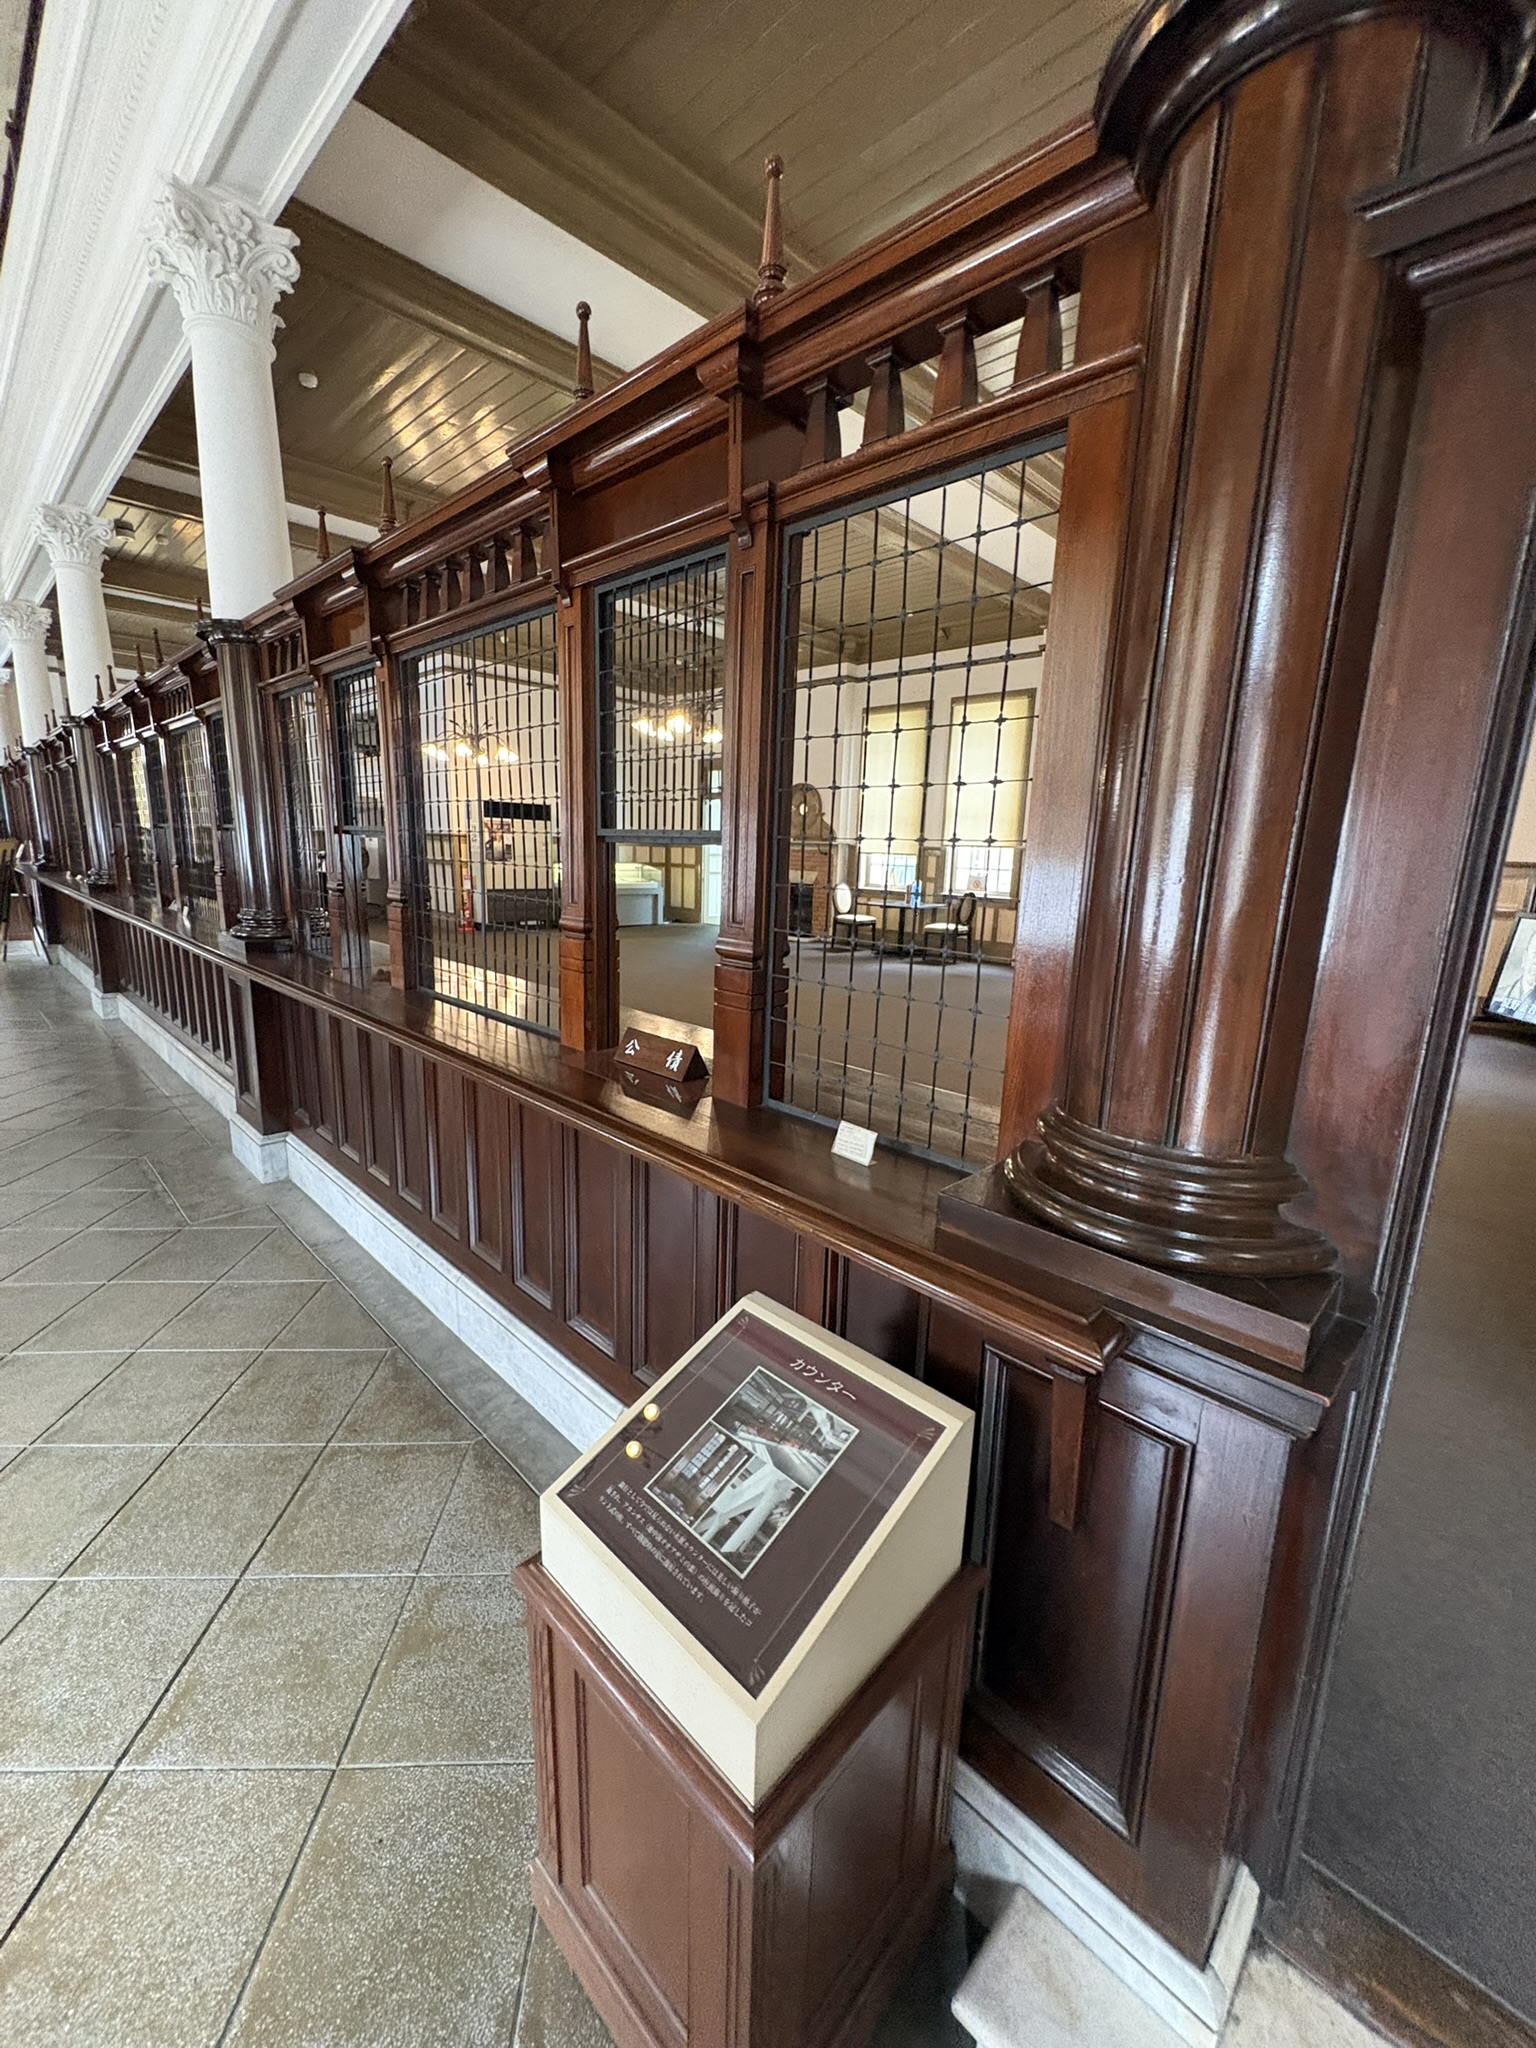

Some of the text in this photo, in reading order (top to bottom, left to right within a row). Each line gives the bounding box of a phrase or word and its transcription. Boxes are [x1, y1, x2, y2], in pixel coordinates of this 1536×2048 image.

[789, 1358, 857, 1402] カウンター
